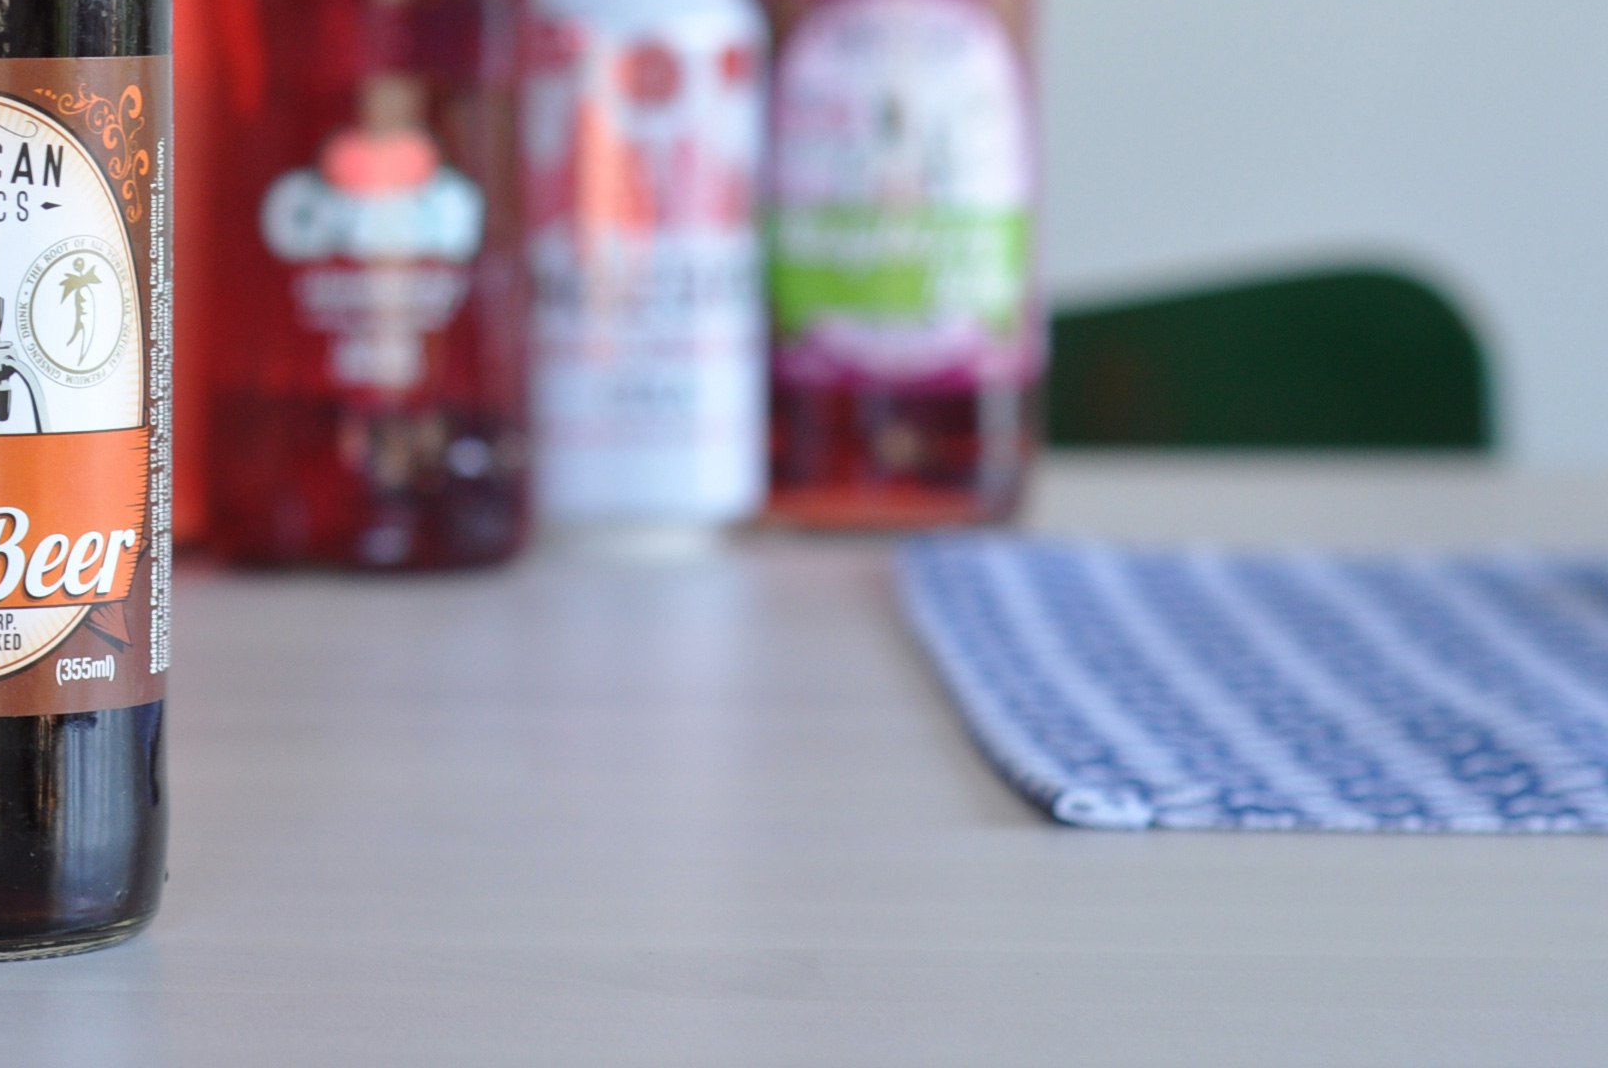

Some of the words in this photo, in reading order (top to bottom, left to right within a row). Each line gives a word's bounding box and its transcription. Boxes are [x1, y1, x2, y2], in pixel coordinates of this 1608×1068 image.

[43, 241, 69, 264] ROOT
[27, 264, 44, 285] THE
[19, 301, 31, 339] DRINK
[26, 342, 62, 380] GINSENG
[55, 654, 115, 686] (355ml)
